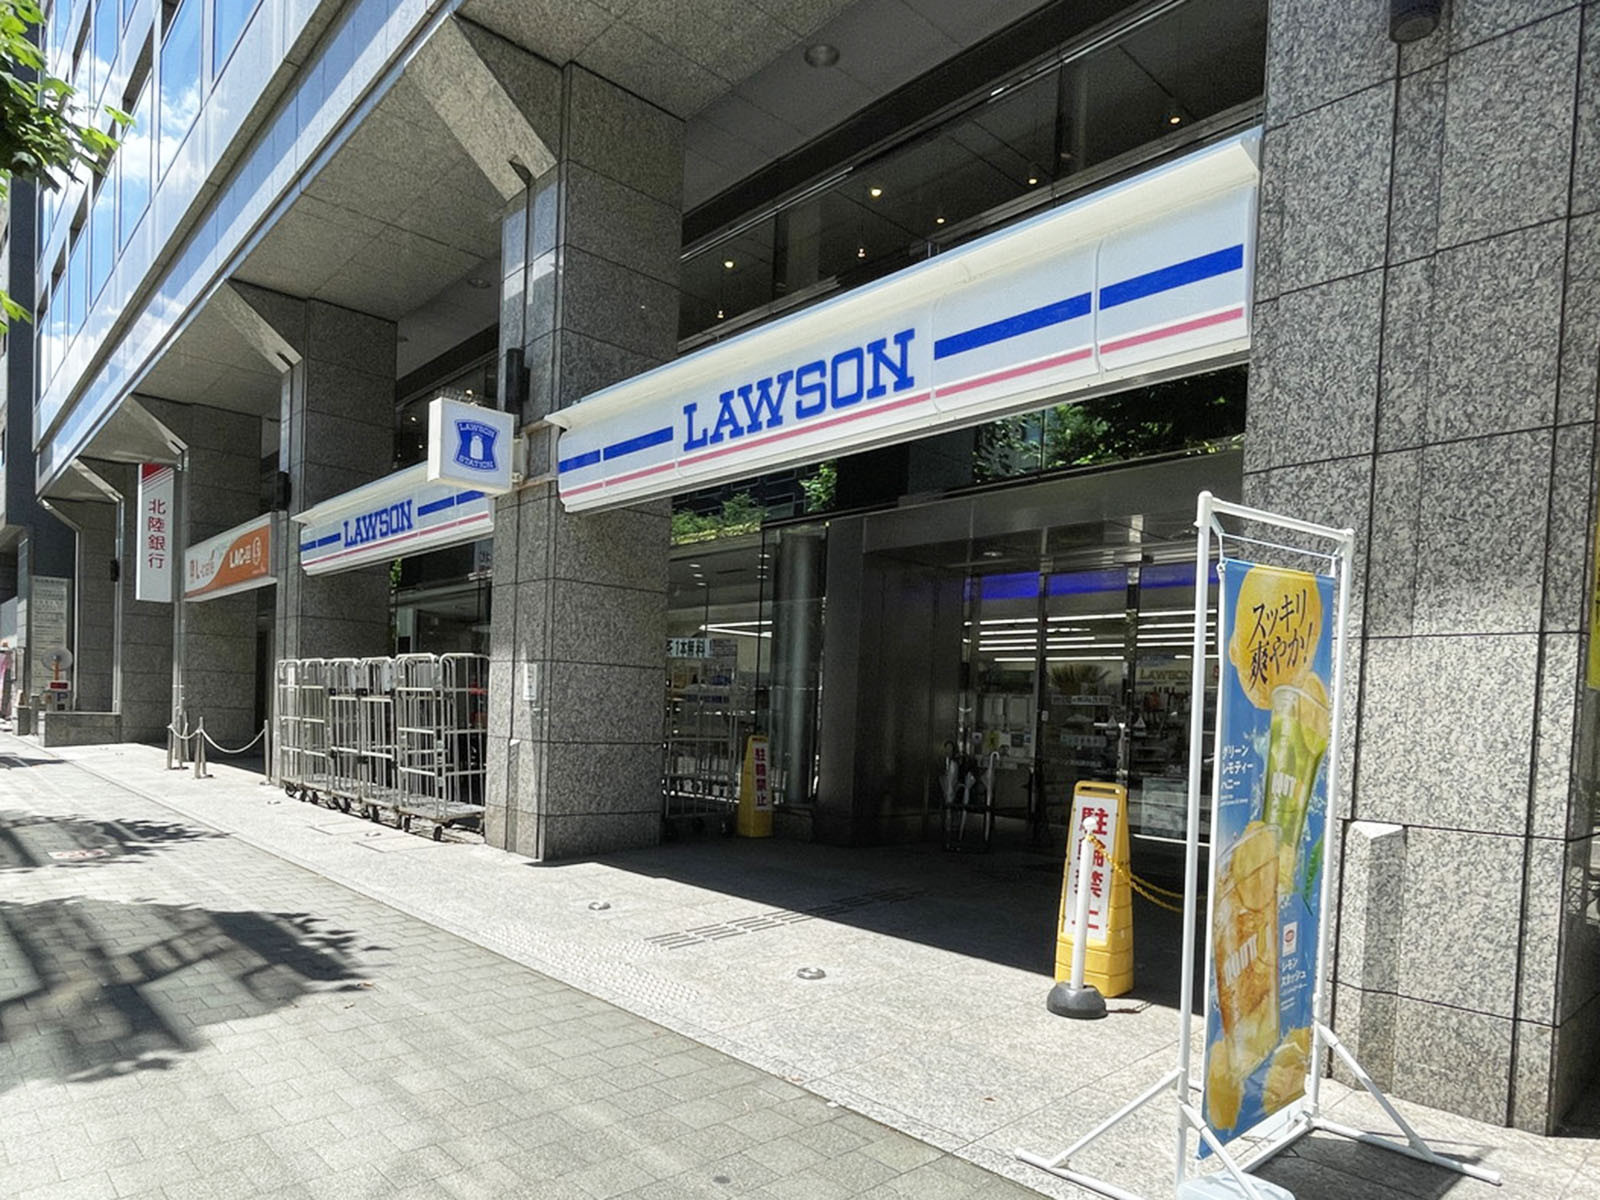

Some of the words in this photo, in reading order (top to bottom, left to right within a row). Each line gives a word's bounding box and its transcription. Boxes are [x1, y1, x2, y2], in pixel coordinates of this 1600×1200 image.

[683, 328, 915, 451] LAWSON
[459, 423, 495, 438] LAWSON
[458, 455, 494, 469] STATION
[148, 498, 166, 569] 北陸銀行
[343, 499, 413, 547] LAWSON
[1248, 589, 1307, 647] スッキリ
[1248, 622, 1313, 690] 爽やか!
